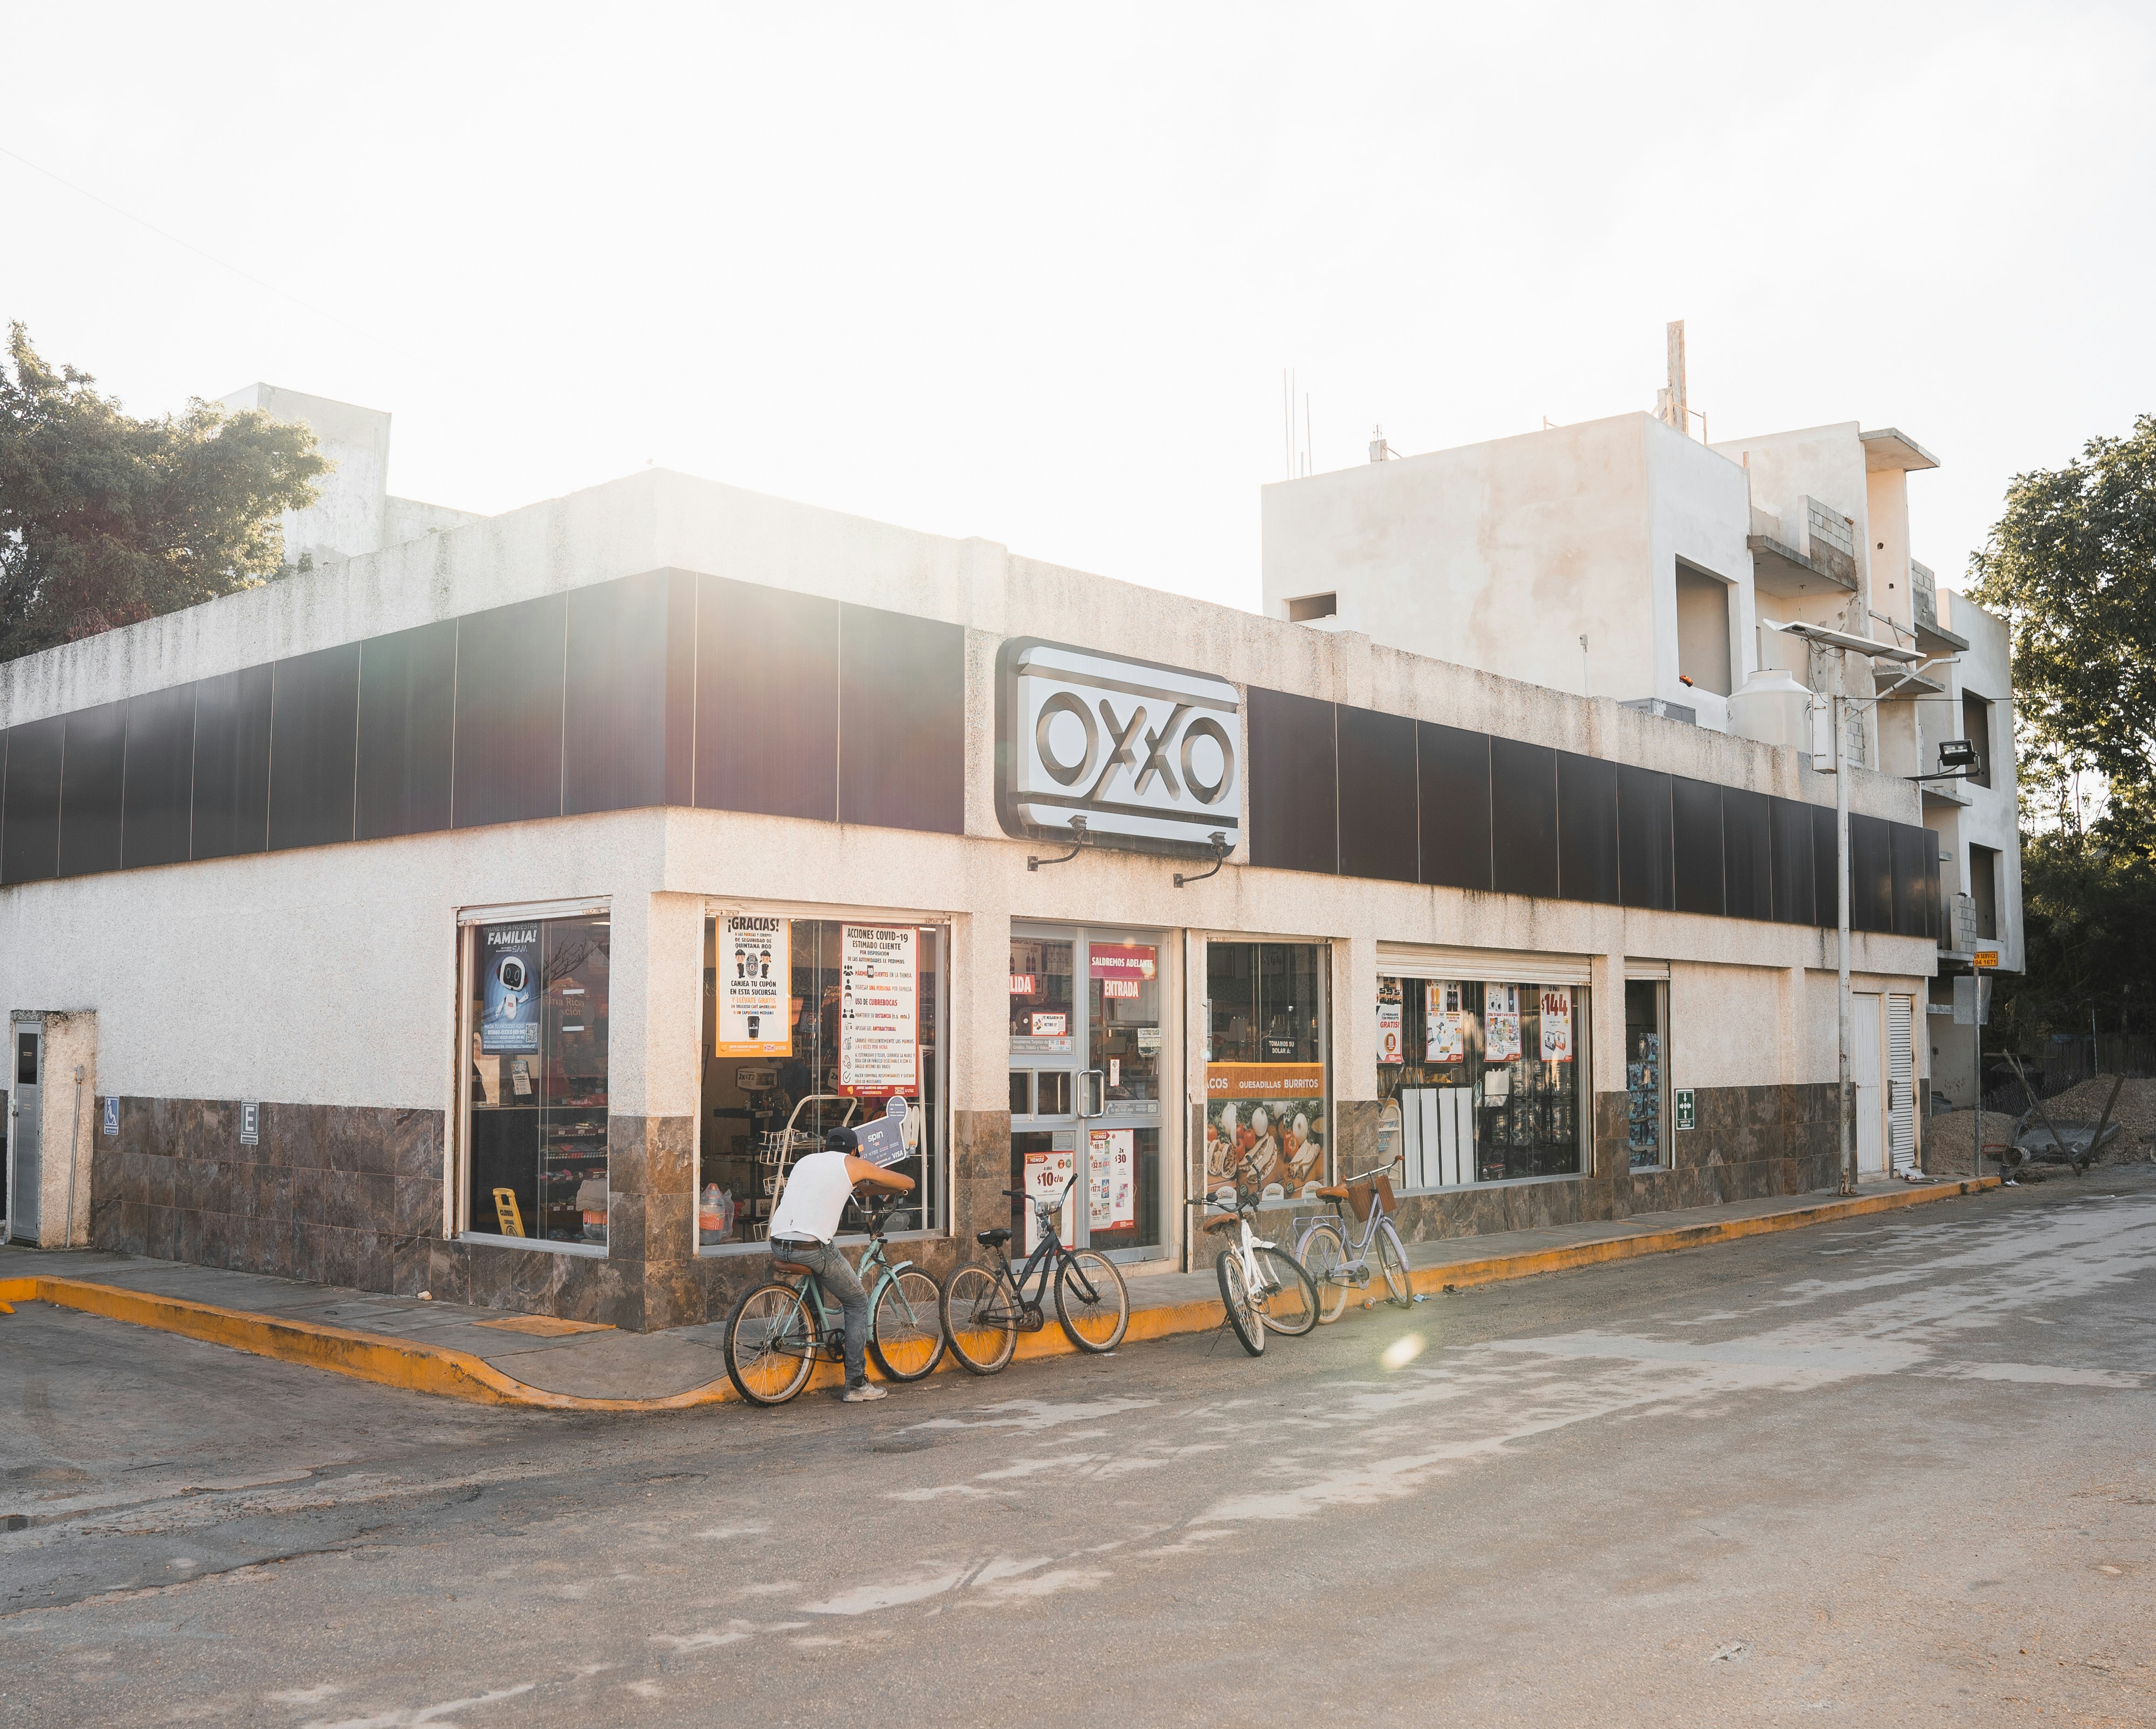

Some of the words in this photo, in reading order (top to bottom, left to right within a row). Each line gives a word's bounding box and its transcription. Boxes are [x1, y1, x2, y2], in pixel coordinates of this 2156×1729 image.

[1036, 692, 1234, 805] OXXO
[728, 917, 780, 932] ¡GRACIAS!
[487, 930, 537, 945] FAMILIA!
[848, 928, 874, 940] ACCIONES
[876, 931, 908, 943] COVID-19
[852, 940, 878, 949] ESTIMADO
[879, 942, 901, 950] CLIENTE
[1092, 957, 1125, 967] SALDREMOS
[1126, 959, 1153, 968] ADELANTE
[867, 968, 873, 976] 10
[1105, 980, 1139, 997] ENTRADA
[1541, 994, 1568, 1016] $144
[1239, 1080, 1281, 1089] QUESADILLAS
[1284, 1079, 1318, 1089] BURRITOS
[245, 1106, 254, 1131] E
[867, 1131, 884, 1143] spin
[892, 1150, 904, 1159] VISA
[1115, 1154, 1126, 1163] $30
[1037, 1172, 1053, 1186] $10
